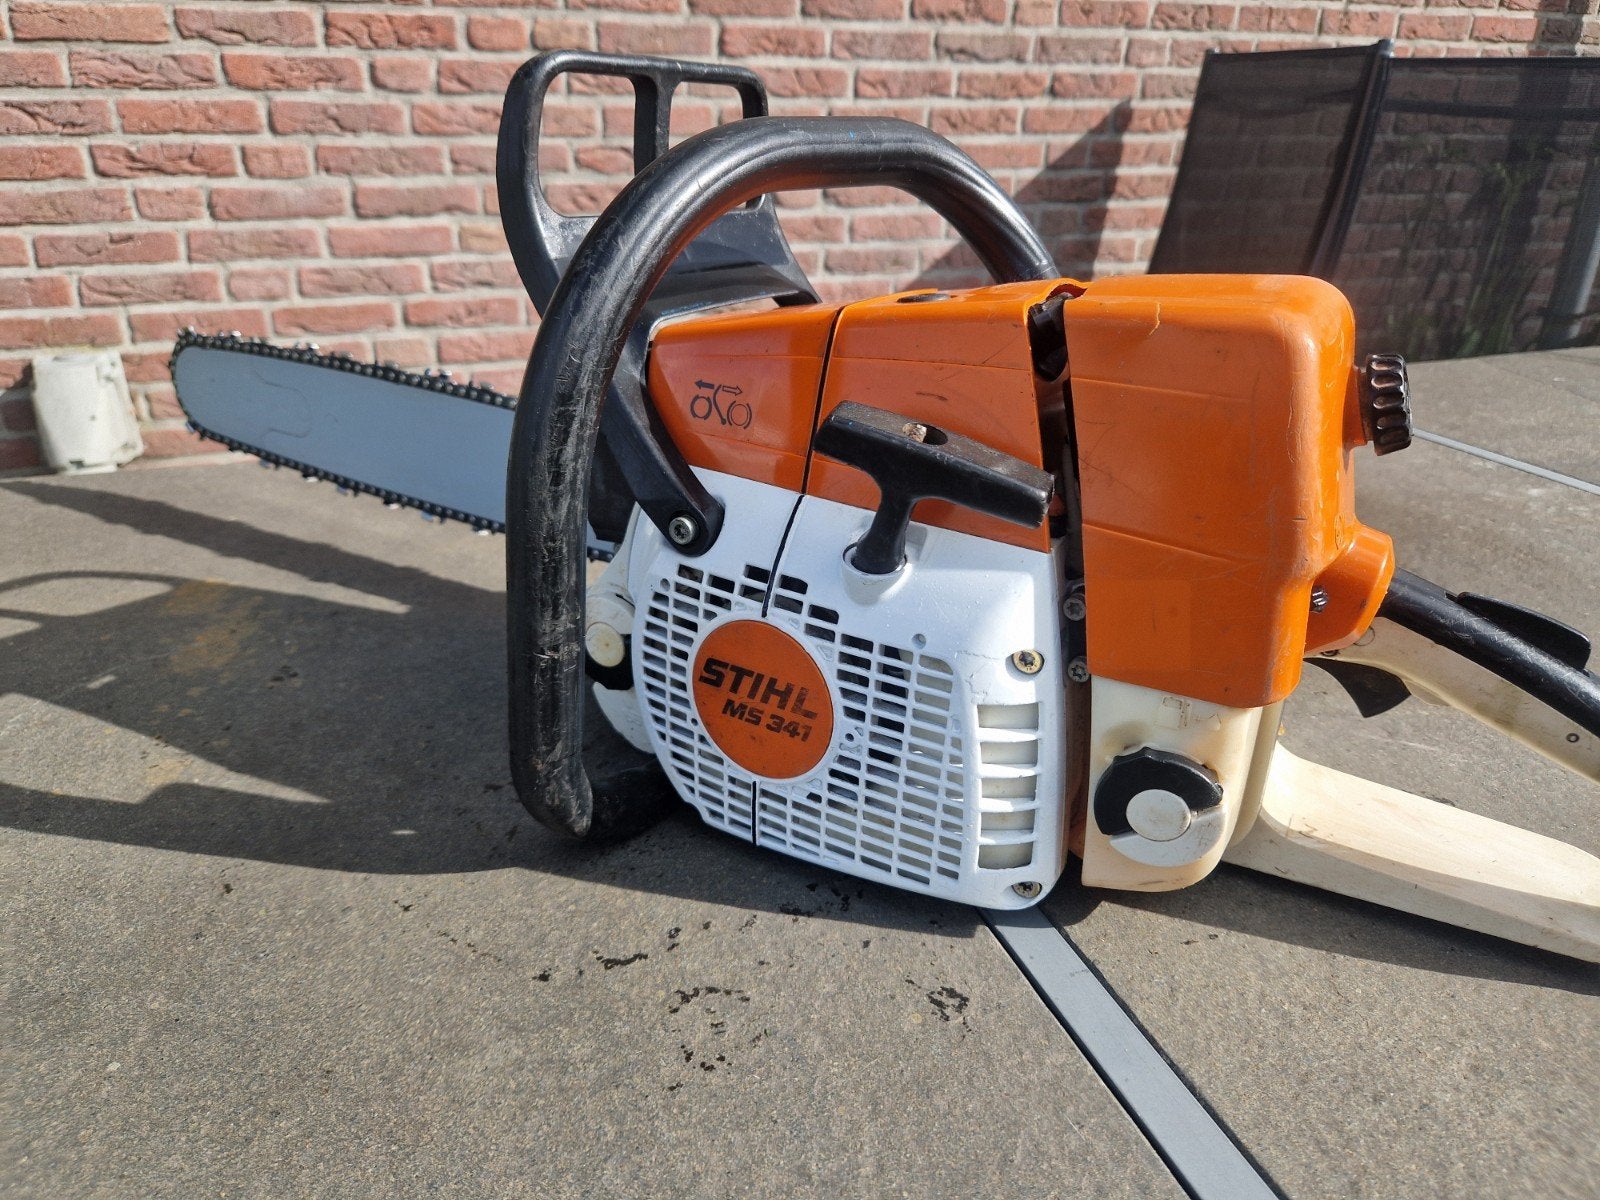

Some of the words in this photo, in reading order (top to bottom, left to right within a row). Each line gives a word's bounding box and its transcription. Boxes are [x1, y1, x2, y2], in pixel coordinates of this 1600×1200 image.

[698, 657, 818, 720] STIHL
[721, 698, 765, 726] MS
[765, 713, 813, 743] 341
